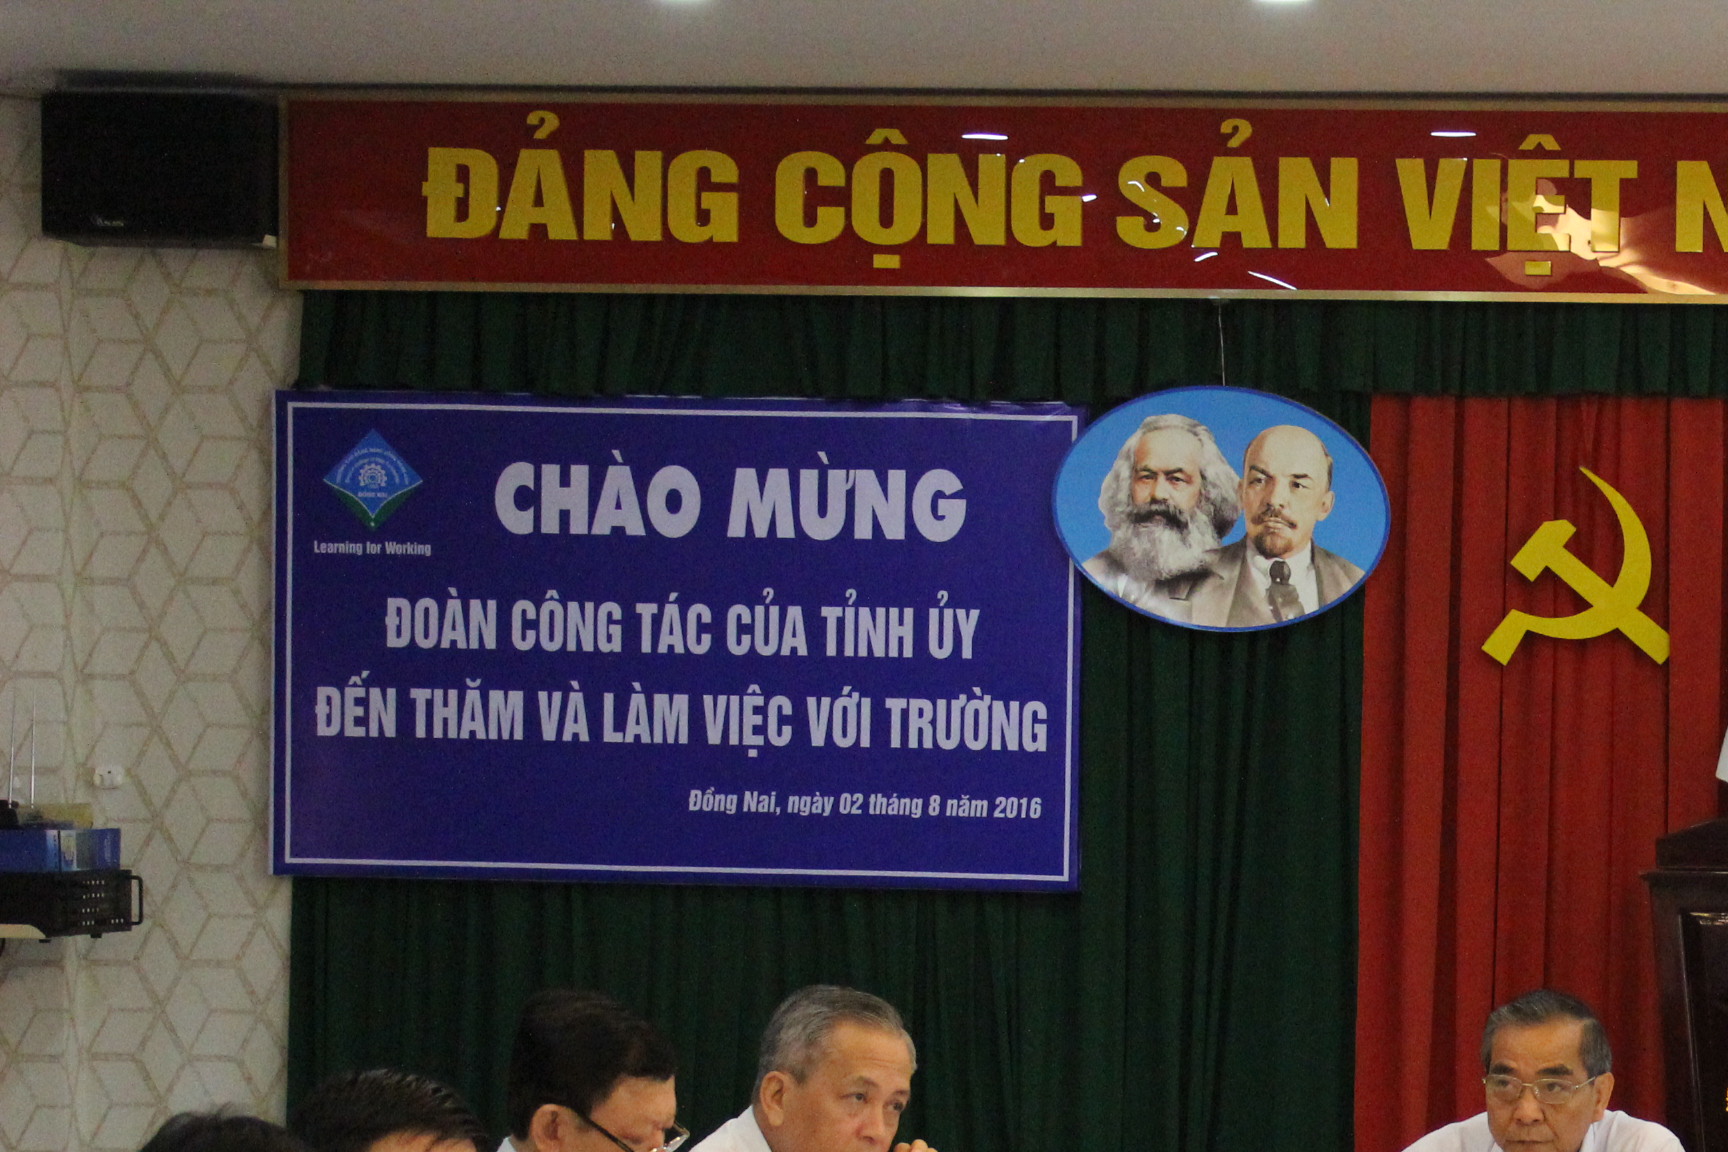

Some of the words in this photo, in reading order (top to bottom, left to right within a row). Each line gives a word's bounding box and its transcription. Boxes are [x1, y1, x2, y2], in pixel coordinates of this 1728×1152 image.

[422, 110, 739, 244] ĐẢNG
[774, 128, 1083, 269] CỘNG
[1115, 118, 1359, 250] SẢN
[1396, 133, 1638, 277] VIỆT
[494, 449, 701, 539] CHÀO
[726, 451, 967, 543] MỪNG
[313, 540, 363, 556] Learning
[366, 541, 382, 554] for
[385, 541, 432, 557] Working
[385, 586, 497, 650] ĐOÀN
[511, 589, 622, 653] CÔNG
[635, 592, 712, 655] TÁC
[726, 587, 808, 657] CỦA
[820, 588, 914, 658] TỈNH
[928, 590, 981, 660] ỦY
[314, 670, 396, 738] ĐẾN
[410, 678, 524, 741] THĂM
[537, 680, 590, 742] VÀ
[603, 681, 689, 744] LÀM
[702, 684, 793, 758] VIỆC
[806, 685, 872, 751] VỚI
[885, 686, 1048, 753] TRƯỜNG
[688, 786, 738, 816] Đồng
[742, 790, 781, 818] Nai,
[787, 791, 835, 818] ngày
[838, 792, 864, 815] 02
[868, 791, 923, 820] tháng
[928, 794, 941, 817] 8
[945, 793, 989, 818] năm
[993, 796, 1042, 819] 2016
